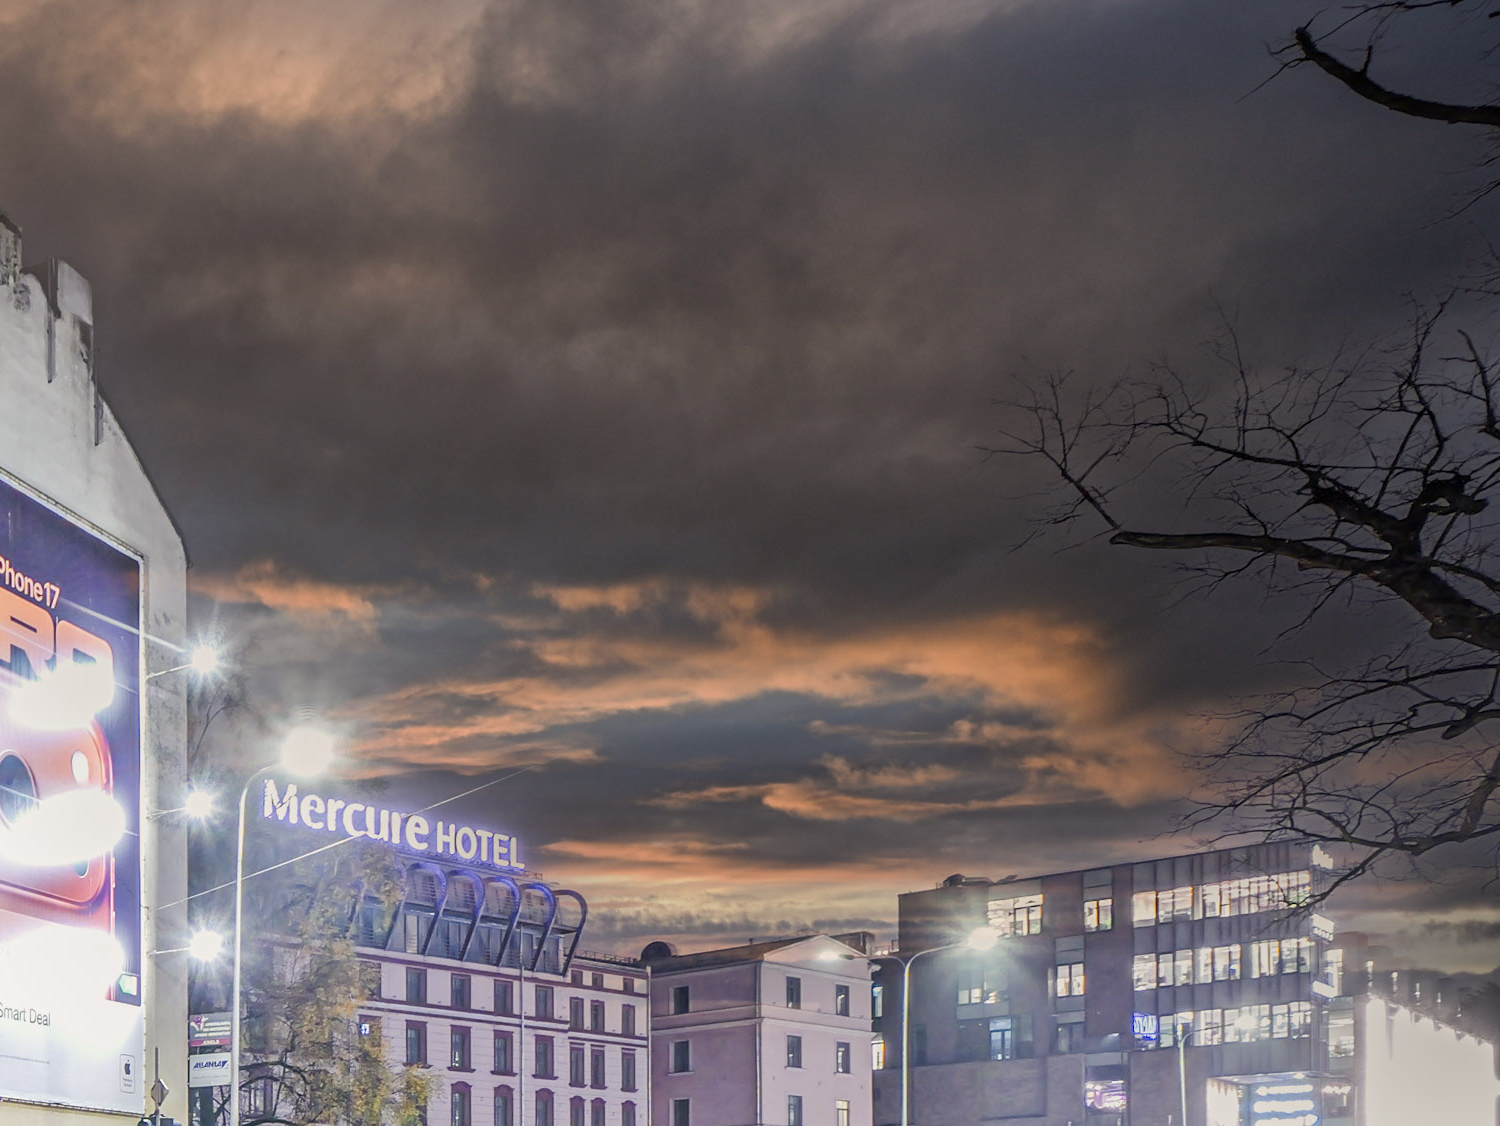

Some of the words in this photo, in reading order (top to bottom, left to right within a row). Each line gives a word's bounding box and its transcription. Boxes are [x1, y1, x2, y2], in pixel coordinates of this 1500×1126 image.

[44, 582, 61, 609] 17
[263, 779, 429, 850] Mercure
[436, 821, 525, 869] HOTEL
[29, 1008, 50, 1027] Deal
